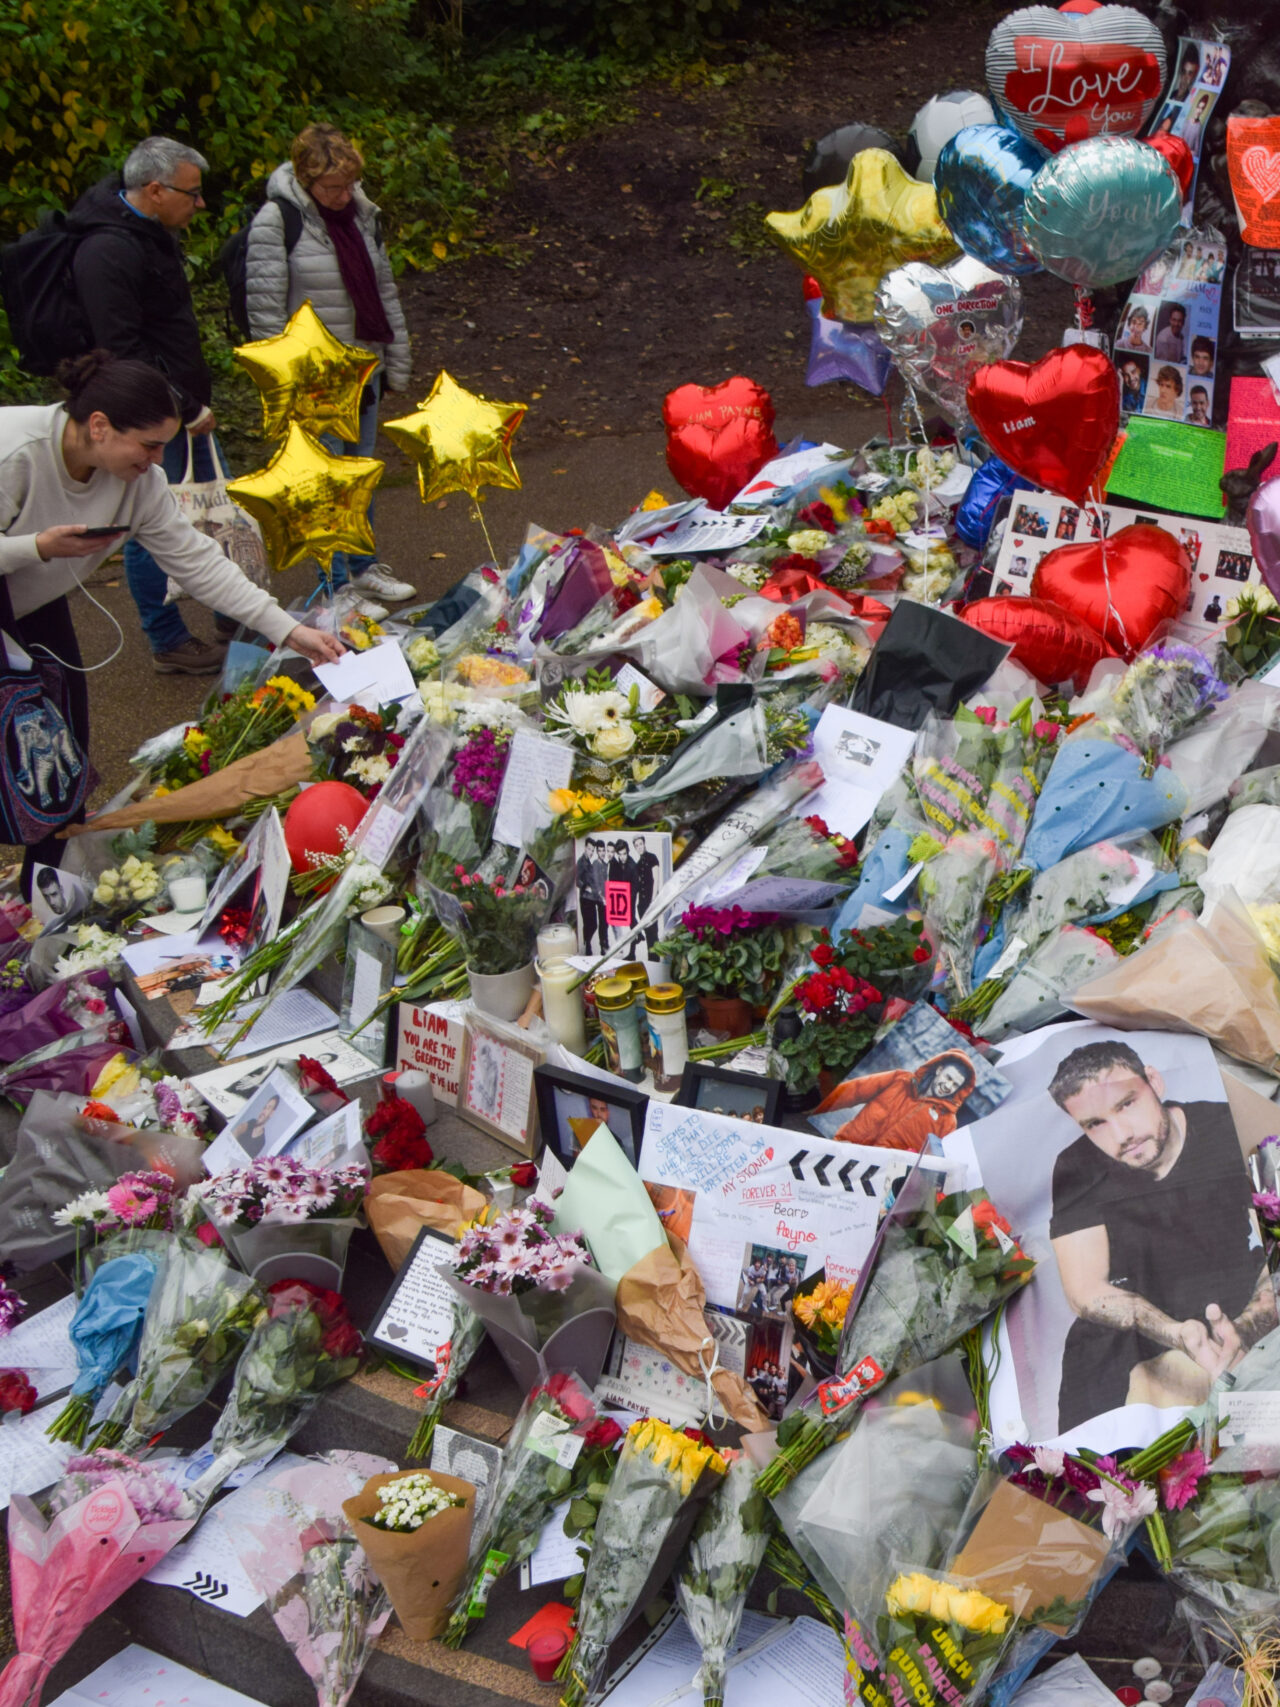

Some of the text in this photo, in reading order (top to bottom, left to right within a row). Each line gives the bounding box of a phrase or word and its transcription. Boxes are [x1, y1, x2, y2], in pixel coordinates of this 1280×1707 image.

[1022, 43, 1143, 115] I Love
[1091, 102, 1136, 131] You
[936, 299, 998, 316] ONE DIRECTION
[718, 406, 761, 419] PAYNE
[1003, 416, 1036, 434] Liam
[609, 893, 628, 916] 1D
[403, 1030, 457, 1060] YOU ARE THE
[414, 1049, 452, 1073] GREATEST
[446, 1081, 460, 1096] LOS
[684, 1114, 700, 1127] TO
[700, 1129, 722, 1151] DIE
[749, 1136, 767, 1155] ON
[716, 1151, 732, 1166] BE
[721, 1155, 768, 1198] MY STONE
[742, 1182, 793, 1200] FOREVER 31
[773, 1202, 802, 1217] Bear
[605, 1391, 650, 1415] LIAM PAYNE
[931, 1627, 973, 1680] UNCH
